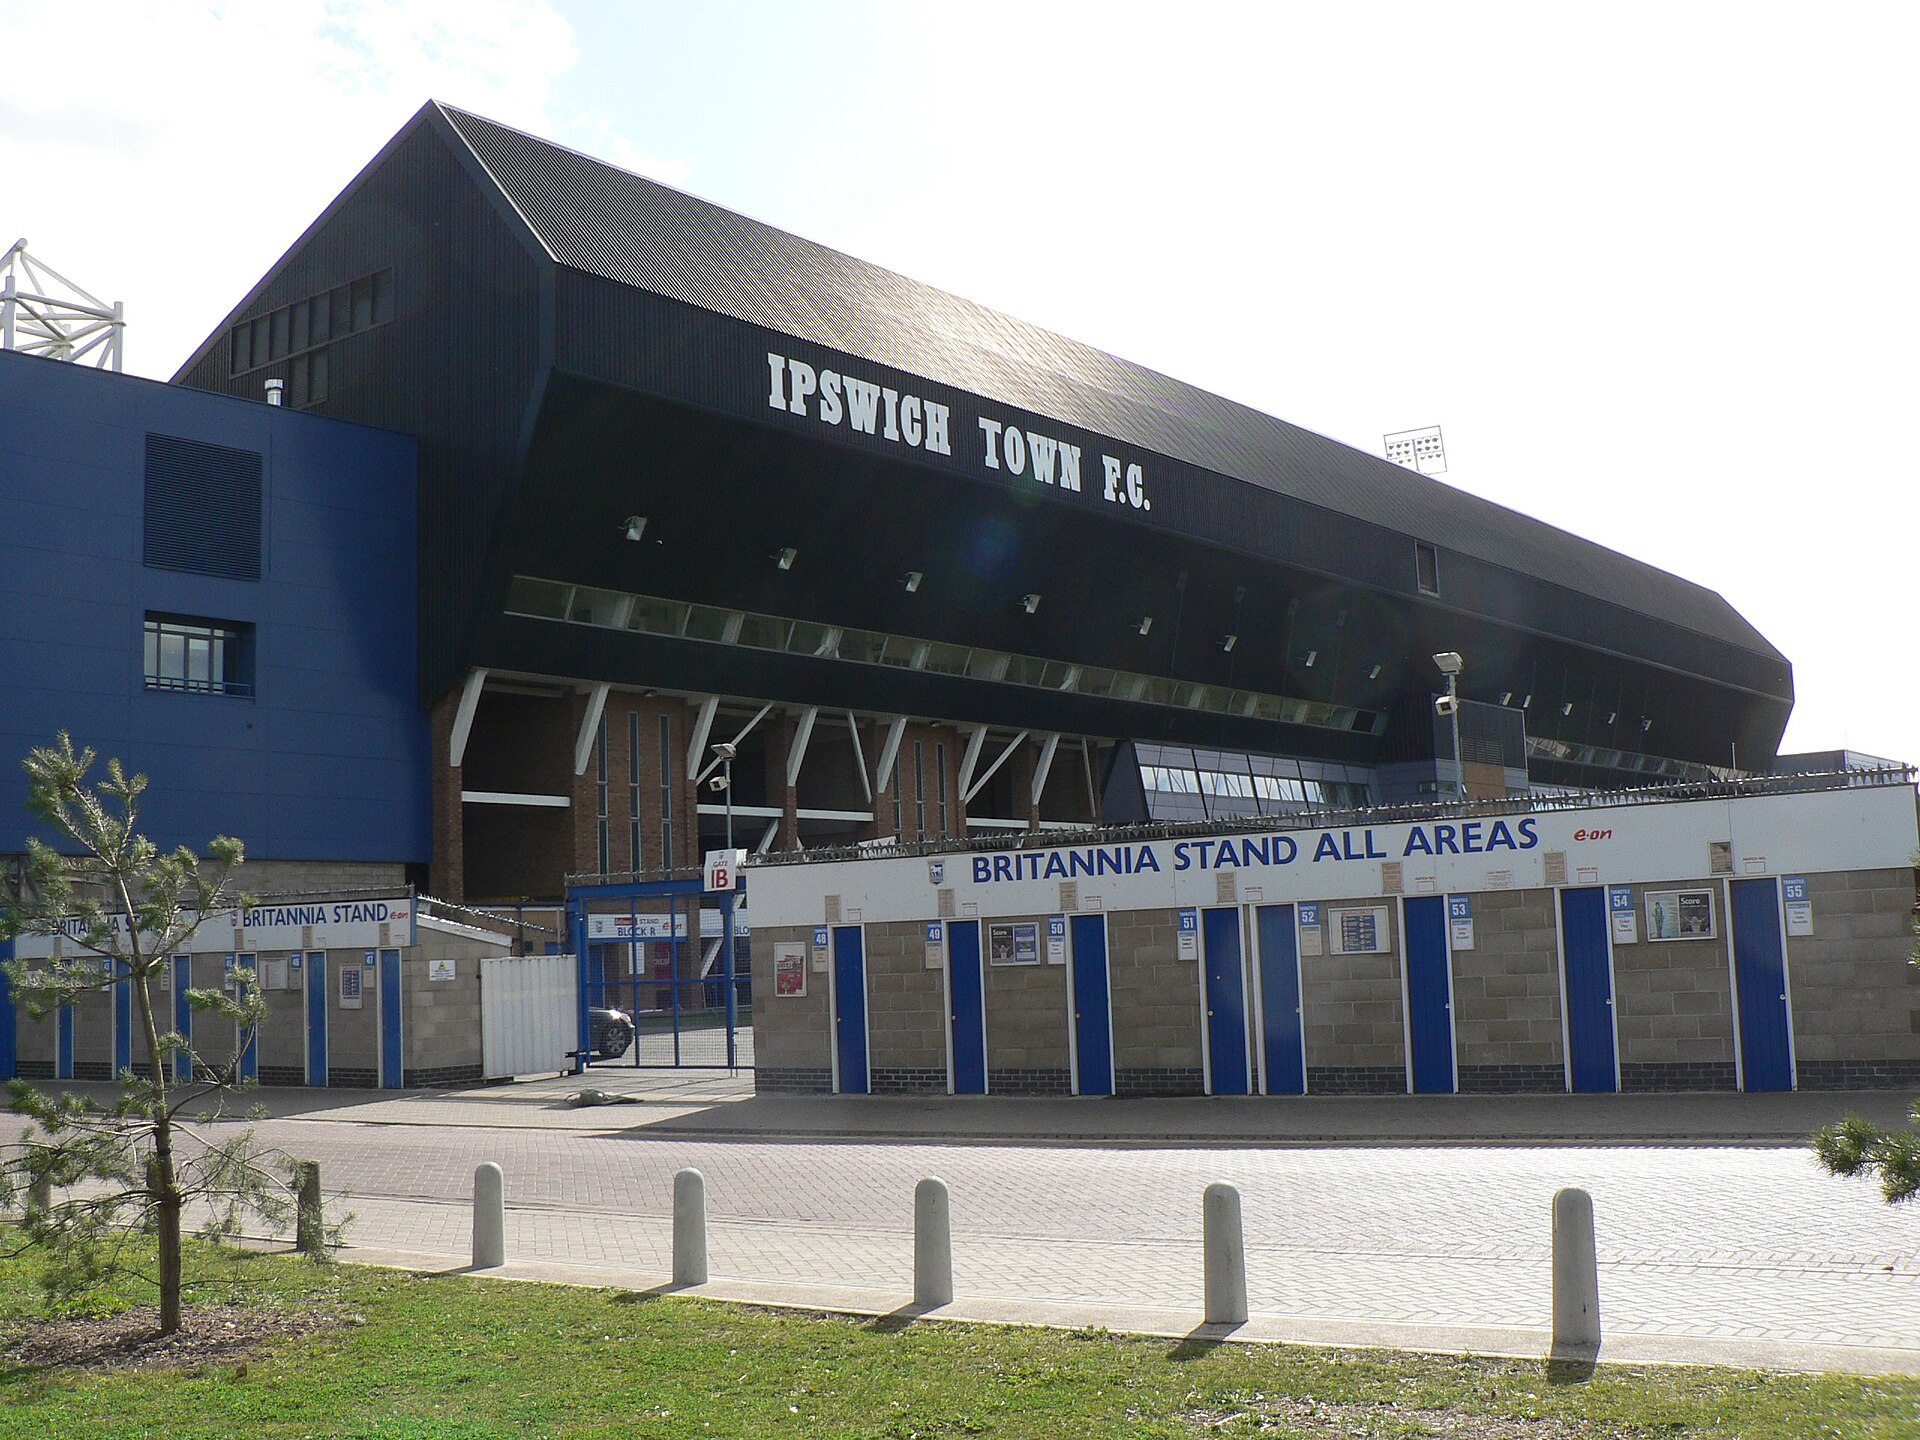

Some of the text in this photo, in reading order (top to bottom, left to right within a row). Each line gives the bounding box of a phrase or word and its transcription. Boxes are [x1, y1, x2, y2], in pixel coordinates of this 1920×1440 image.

[767, 352, 1151, 511] IPSWICH TOWN F.C.
[972, 818, 1538, 883] BRITANNIA STAND ALL AREAS
[1787, 885, 1802, 898] 55
[1613, 895, 1628, 907] 54
[1680, 897, 1701, 905] Score
[1452, 904, 1466, 915] 53
[242, 903, 388, 928] BRITANNIA STAND
[1301, 911, 1315, 922] 52
[1183, 917, 1194, 928] 51
[650, 927, 656, 936] R
[929, 928, 940, 940] 49
[1051, 923, 1063, 934] 50
[816, 933, 827, 944] 48
[365, 955, 374, 965] 47
